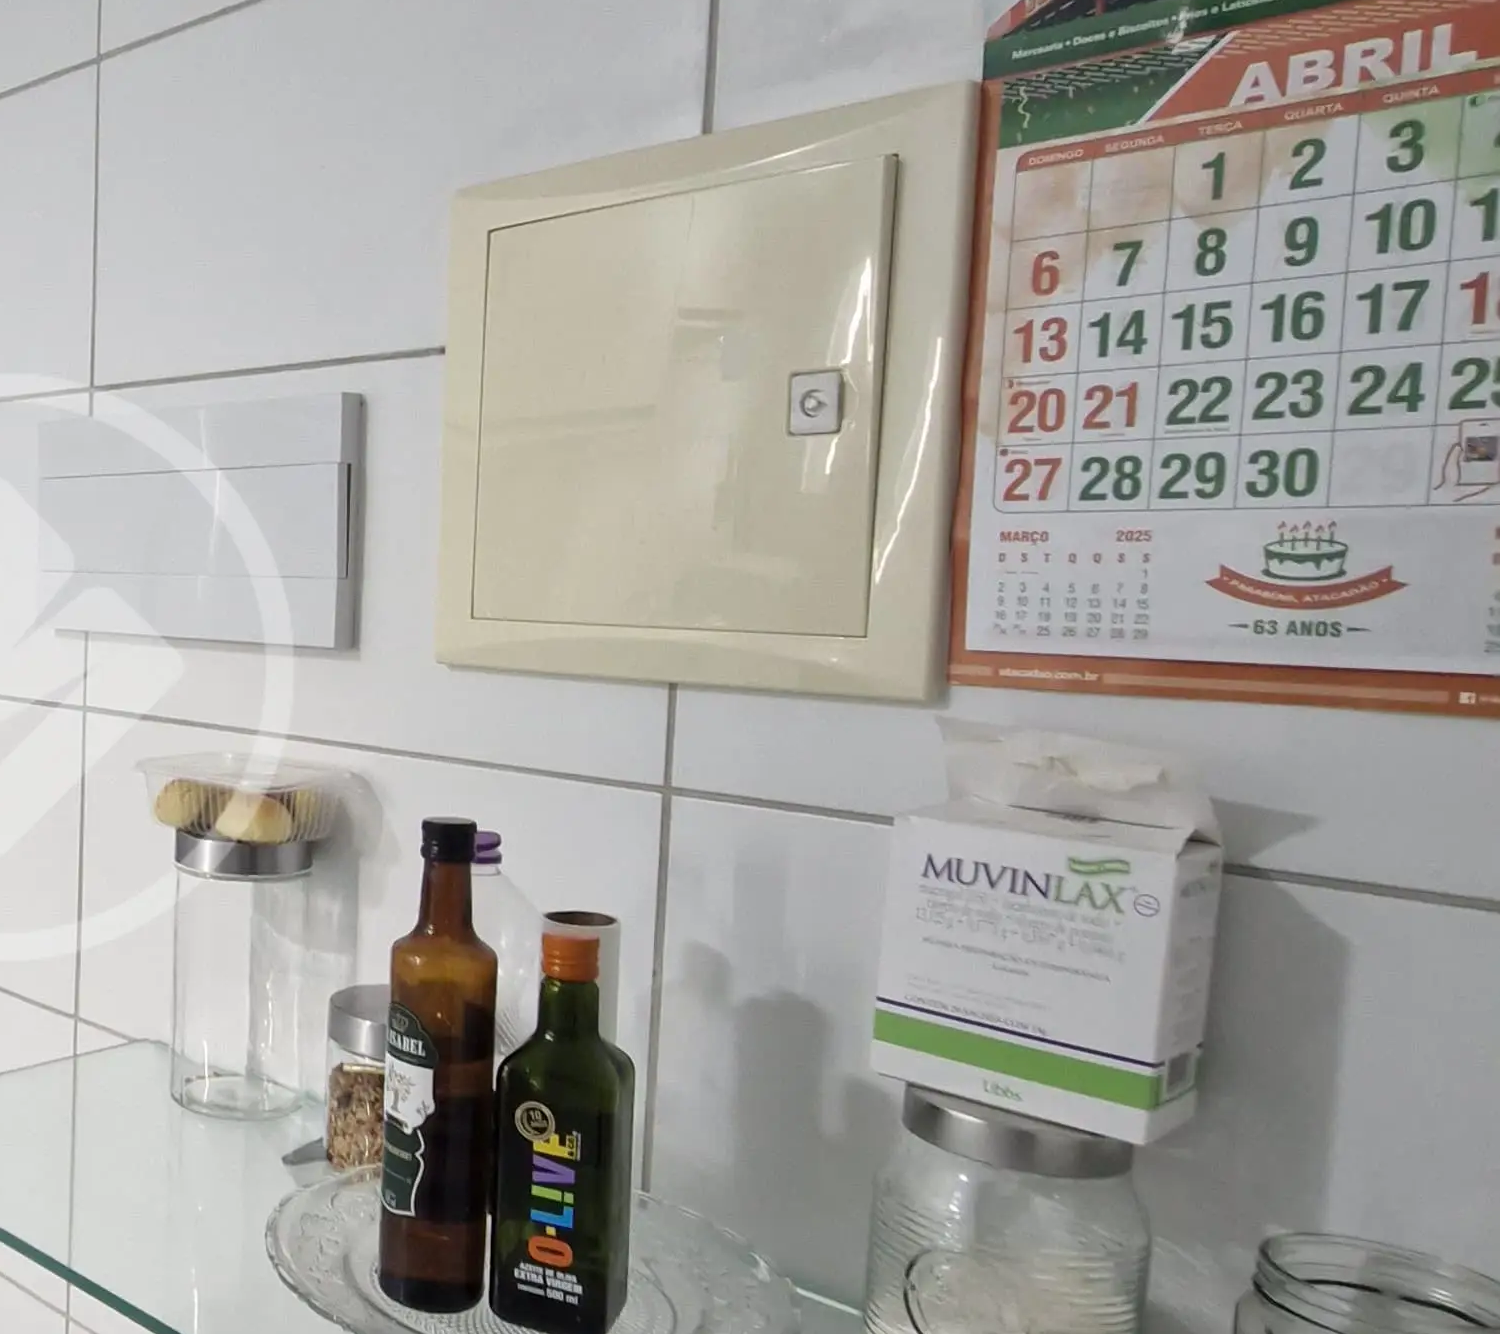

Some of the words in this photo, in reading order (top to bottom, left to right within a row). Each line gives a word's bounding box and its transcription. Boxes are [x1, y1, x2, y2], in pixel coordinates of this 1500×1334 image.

[1228, 24, 1477, 108] ABRIL
[1028, 148, 1084, 166] DOMINGO
[1105, 134, 1164, 152] SEGUNDA
[1284, 102, 1344, 120] QUARTA
[1382, 85, 1439, 104] QUINTA
[1202, 152, 1226, 200] 1
[1289, 138, 1327, 190] 2
[1386, 119, 1425, 173] 3
[1031, 250, 1060, 296] 6
[1112, 240, 1144, 287] 7
[1195, 228, 1227, 276] 8
[1284, 216, 1319, 267] 9
[1366, 198, 1436, 255] 10
[1014, 317, 1068, 364] 13
[1089, 309, 1147, 358] 14
[1172, 300, 1233, 351] 15
[1260, 291, 1325, 343] 16
[1357, 279, 1430, 334] 17
[1460, 271, 1500, 325] 1
[1007, 388, 1066, 433] 20
[1082, 381, 1138, 430] 21
[1166, 376, 1233, 425] 22
[1252, 369, 1325, 420] 23
[1347, 362, 1425, 416] 24
[1448, 357, 1500, 410] 2
[1003, 458, 1062, 501] 27
[1078, 455, 1143, 501] 28
[1158, 452, 1226, 500] 29
[1246, 447, 1319, 498] 30
[999, 530, 1050, 546] MARÇO
[1115, 529, 1153, 543] 2025
[1253, 619, 1278, 636] 63
[1286, 620, 1342, 638] ANOS
[921, 853, 1125, 914] MUVINLAX
[984, 1078, 1023, 1102] Libbs
[514, 1267, 544, 1285] EXTRA
